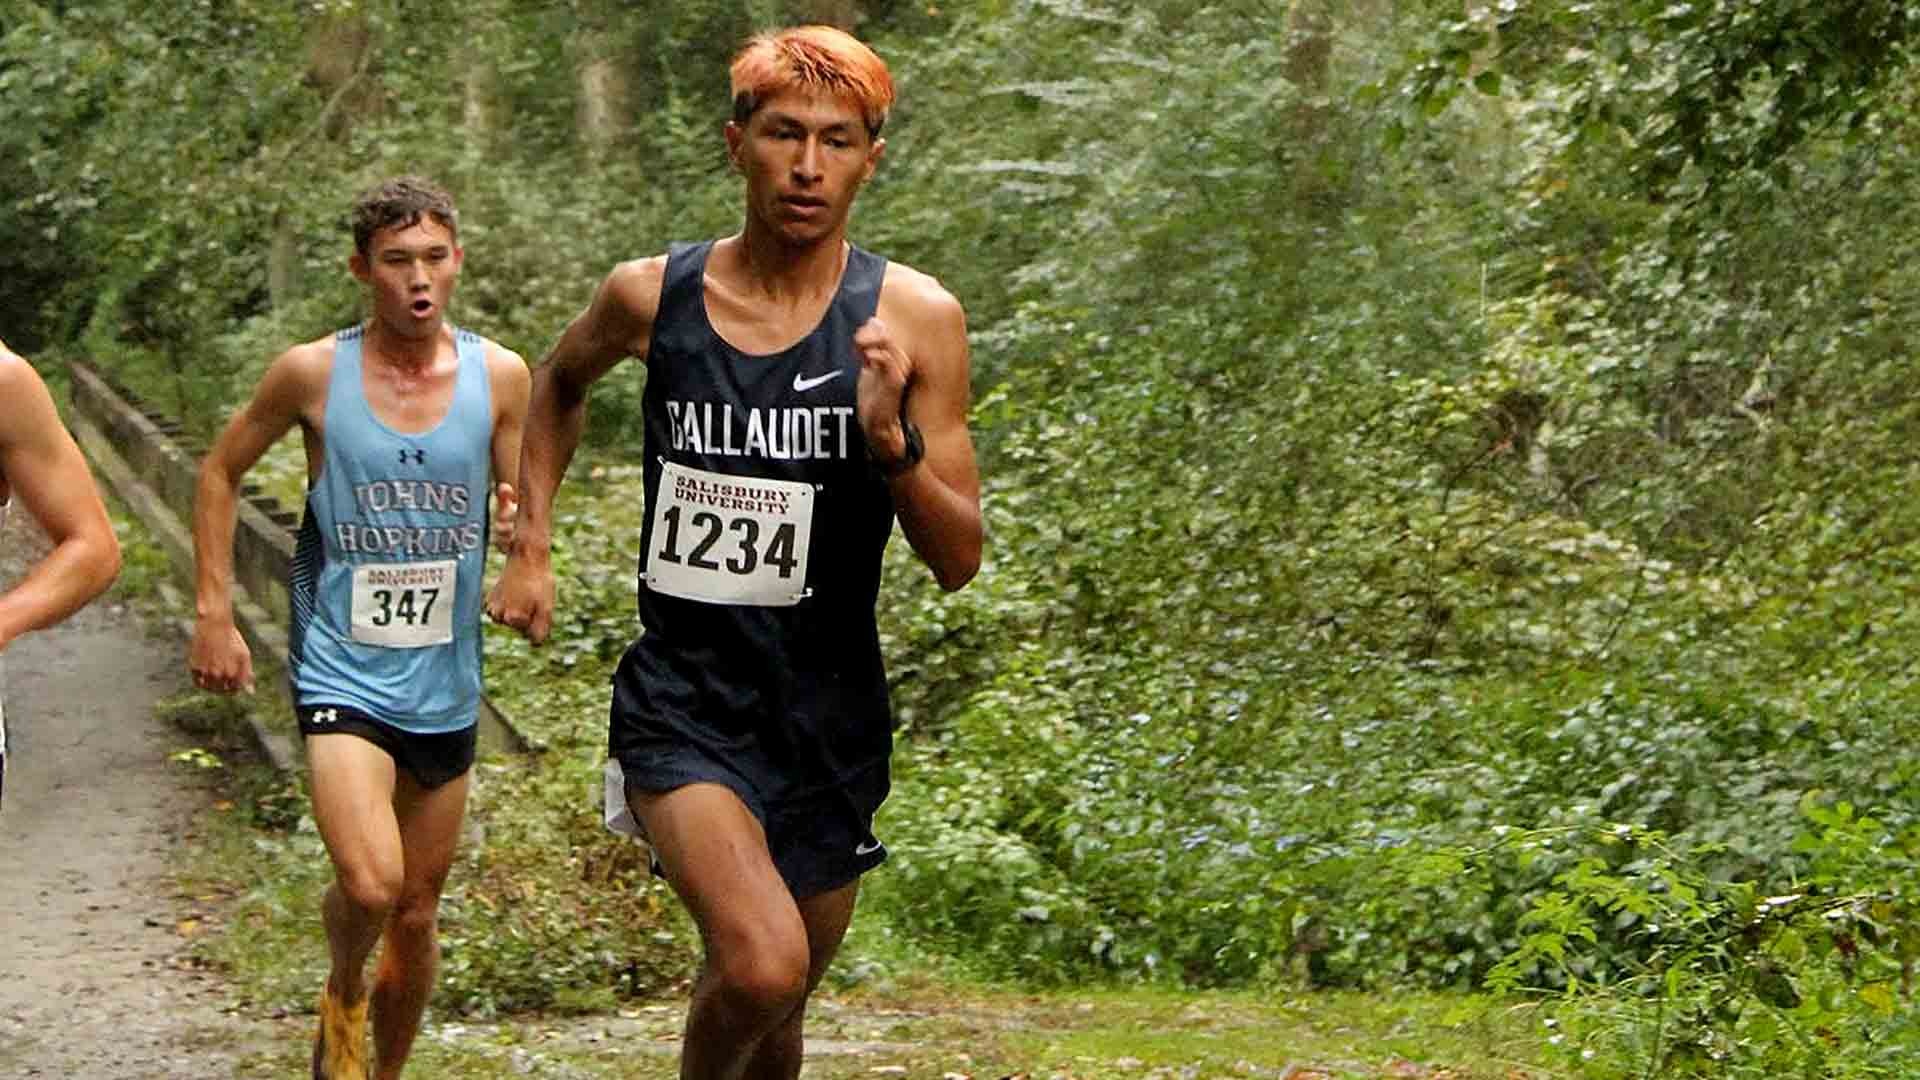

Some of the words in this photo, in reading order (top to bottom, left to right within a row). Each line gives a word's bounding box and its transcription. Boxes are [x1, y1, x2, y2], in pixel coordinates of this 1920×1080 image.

[674, 488, 790, 515] UNIVERSITY
[676, 476, 791, 502] SALISBURY
[336, 522, 480, 555] HOPKINS
[658, 506, 798, 579] 1234
[371, 588, 440, 627] 347
